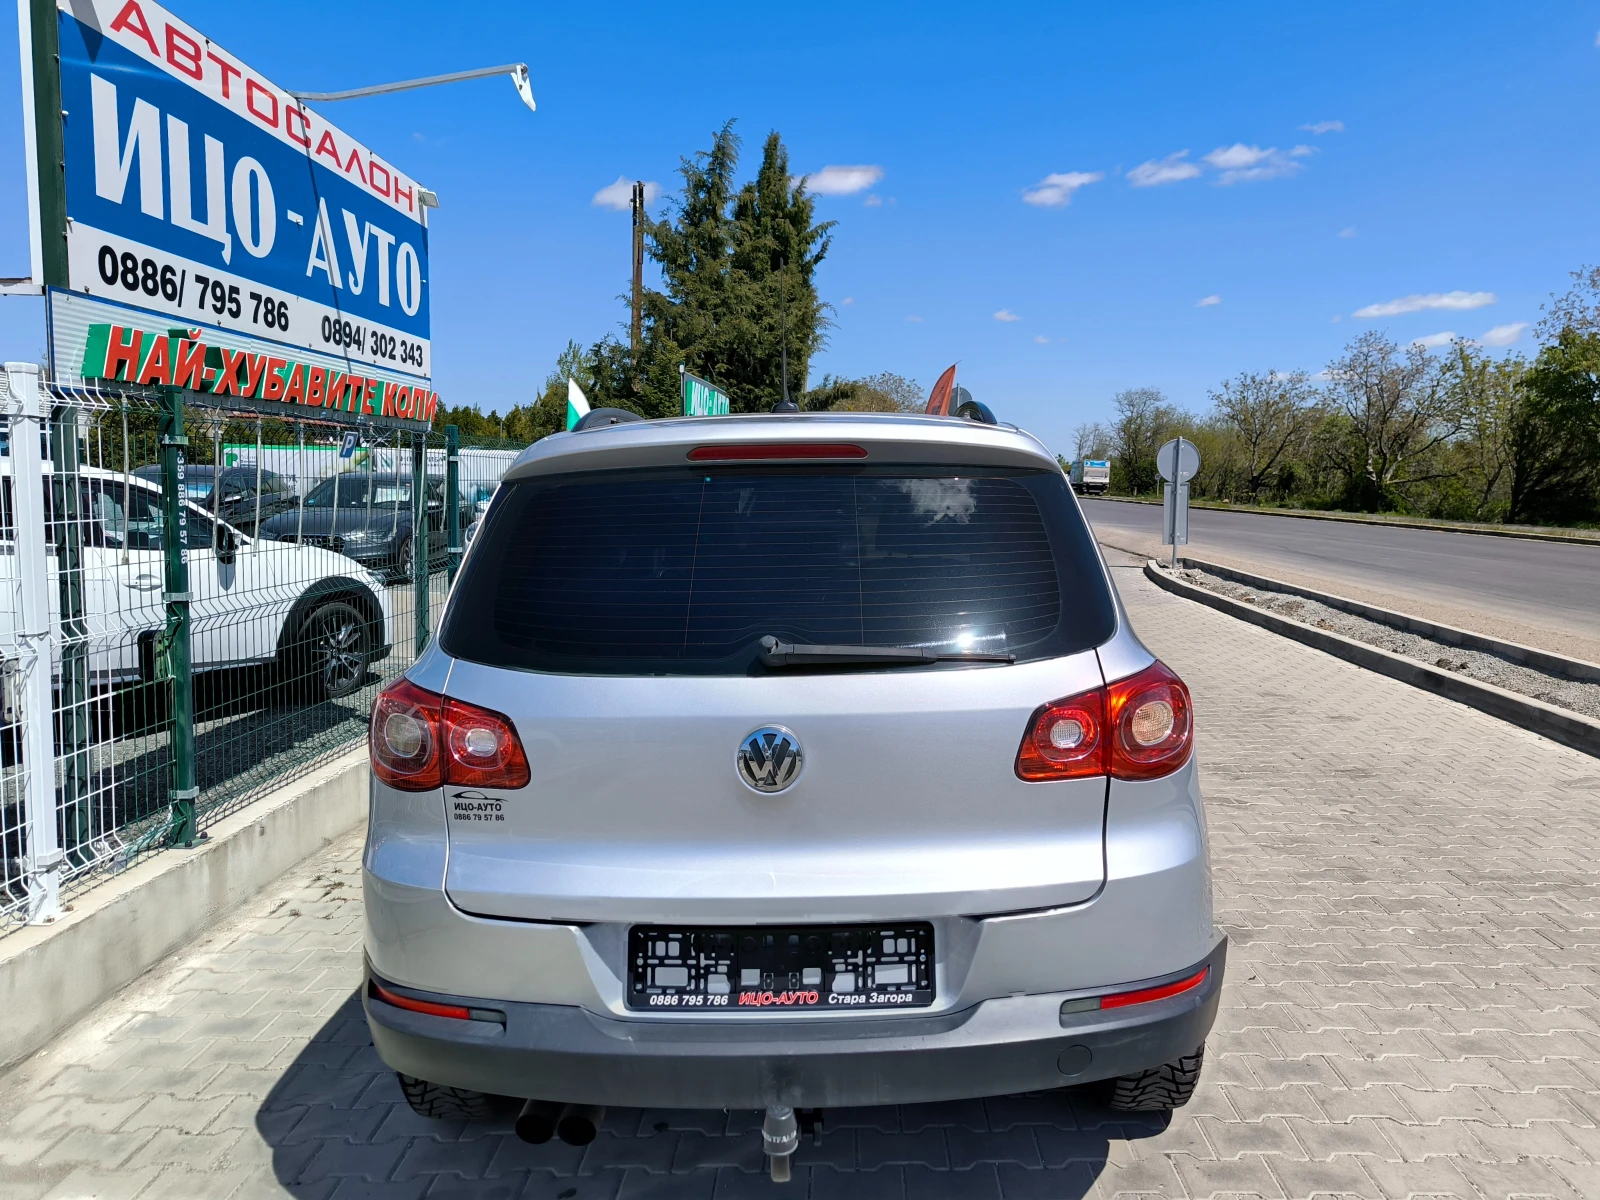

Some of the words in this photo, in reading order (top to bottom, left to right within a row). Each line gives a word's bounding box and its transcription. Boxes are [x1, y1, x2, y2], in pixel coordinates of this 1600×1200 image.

[110, 0, 413, 212] АВТОСАЛОН
[98, 245, 186, 308] 0886/
[195, 274, 241, 319] 795
[250, 291, 289, 332] 786
[321, 315, 366, 355] 0894/
[370, 331, 396, 361] 302
[400, 340, 423, 368] 343
[102, 325, 377, 415] НАЙ-ХУБАВИТЕ
[381, 381, 437, 422] КОЛИ
[343, 435, 354, 455] P
[177, 449, 185, 480] +359
[178, 483, 186, 507] 886
[179, 510, 187, 526] 79
[180, 532, 188, 545] 57
[181, 549, 188, 564] 86
[454, 802, 502, 812] ИЦО-АУТО
[453, 813, 471, 821] 0886
[484, 814, 493, 822] 57
[650, 995, 678, 1006] 0886
[682, 995, 704, 1006] 795
[706, 995, 729, 1006] 786
[738, 991, 819, 1006] ИЦО-АУТО
[828, 993, 866, 1005] Стара
[869, 992, 913, 1004] Загора
